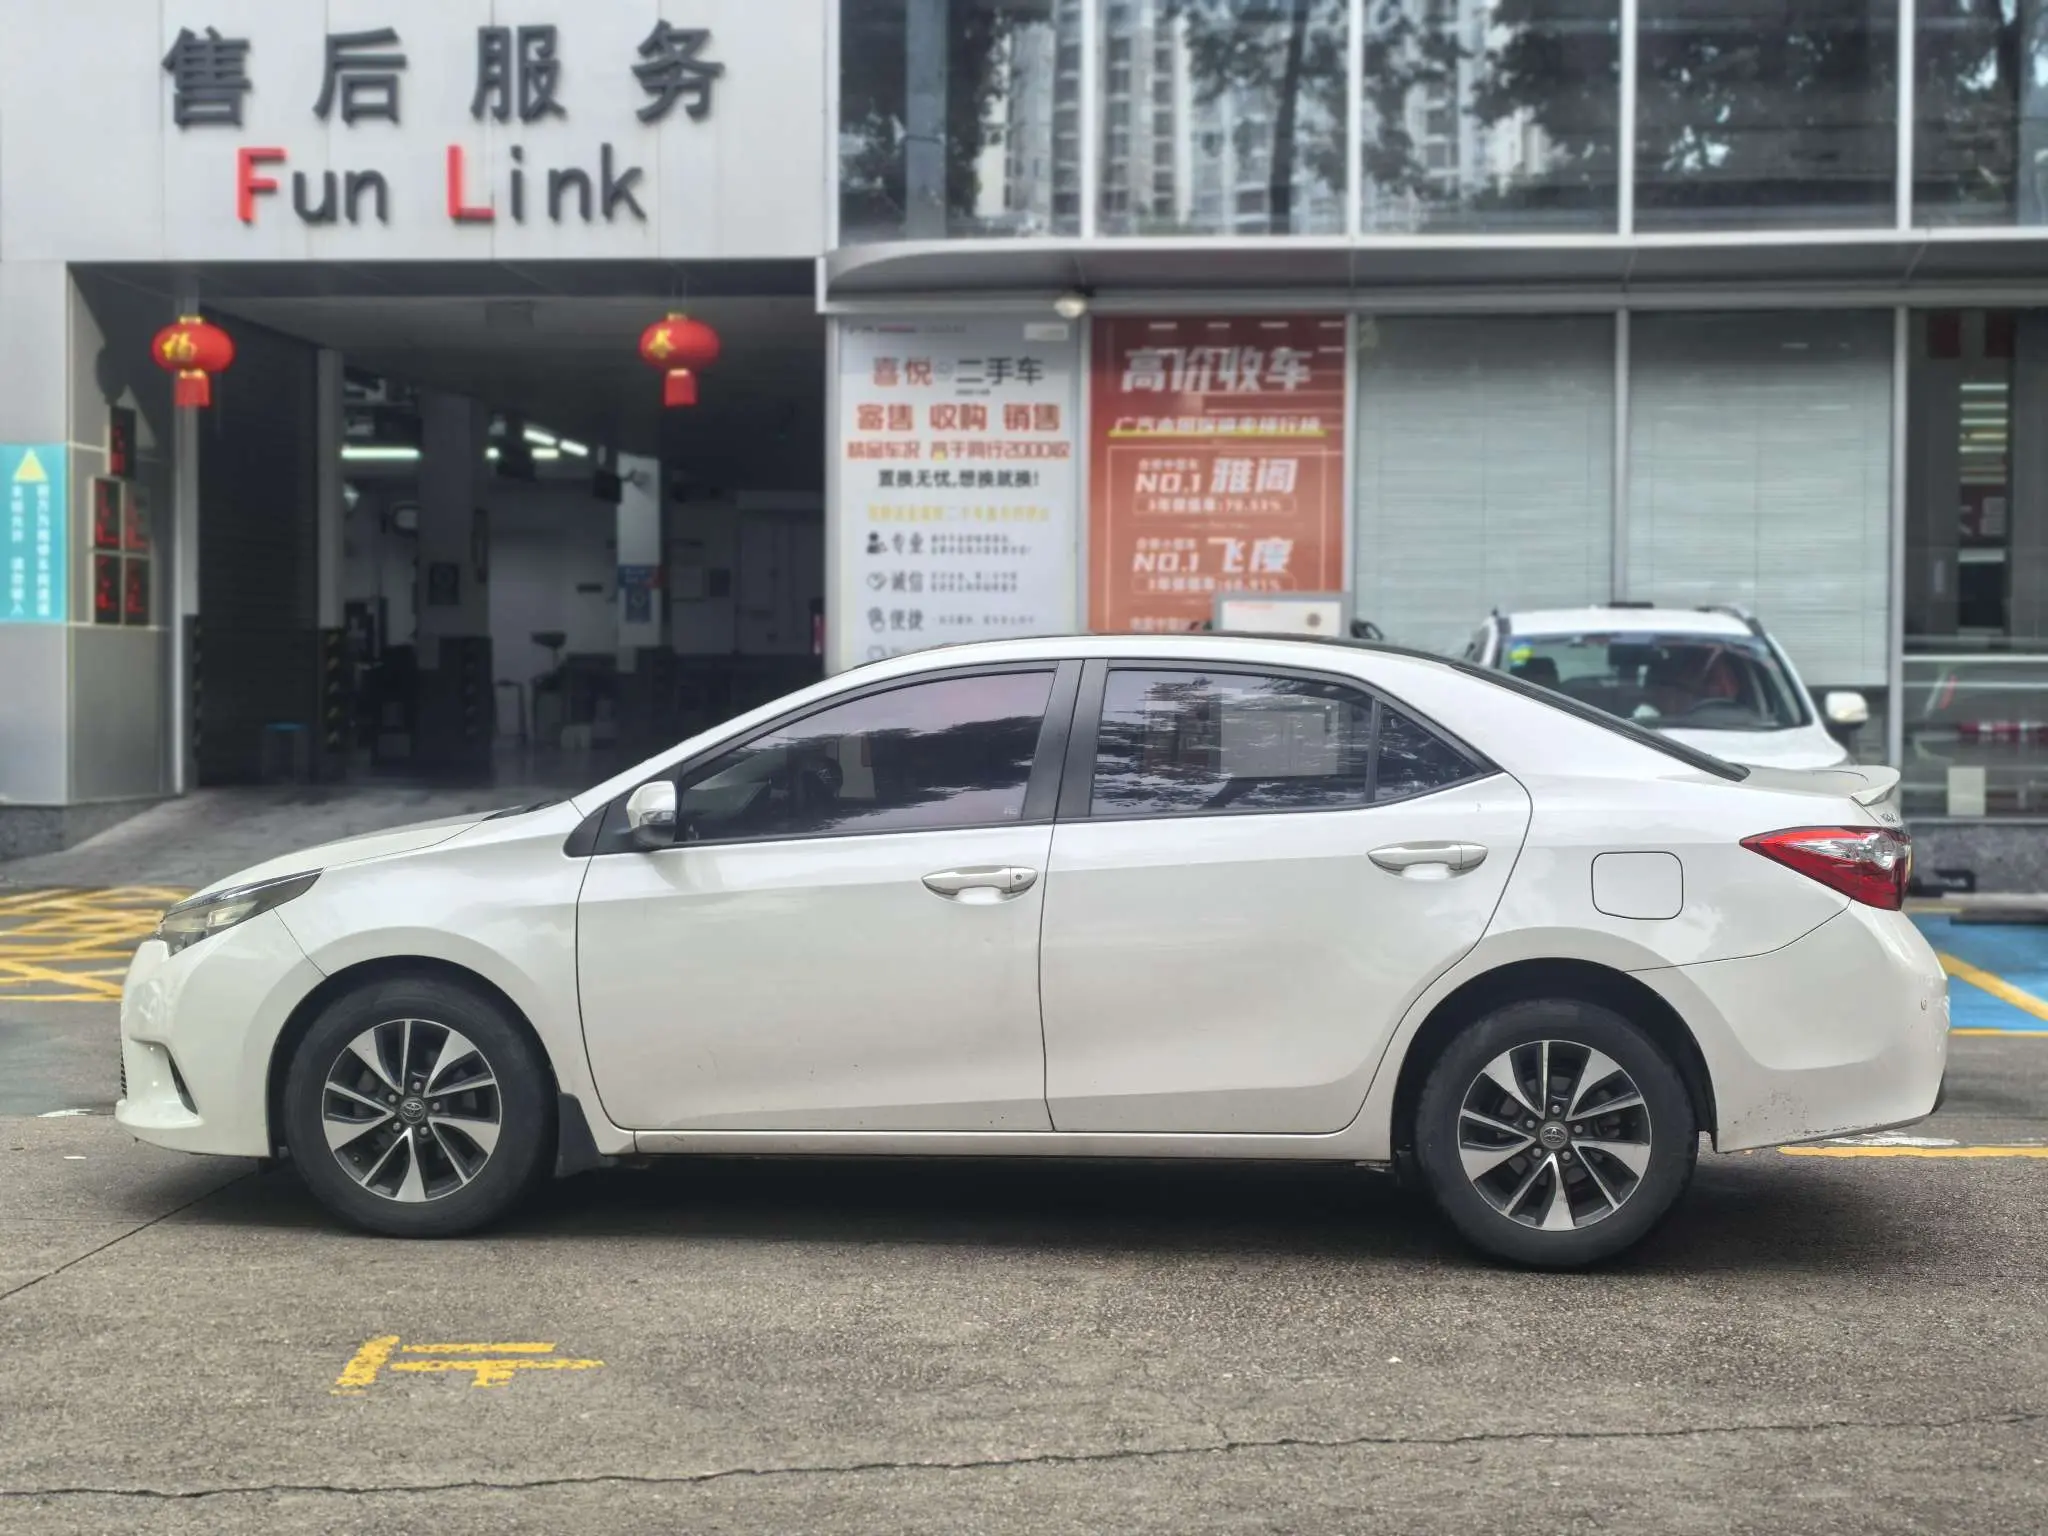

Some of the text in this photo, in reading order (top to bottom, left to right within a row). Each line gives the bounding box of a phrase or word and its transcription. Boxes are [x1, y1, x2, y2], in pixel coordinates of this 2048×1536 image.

[161, 18, 727, 127] 售后服务
[236, 142, 650, 226] Fun Link
[872, 355, 1045, 387] 喜悦 二手车
[1119, 346, 1314, 394] 高价收车
[856, 402, 1061, 432] 寄售 收购 销售
[1135, 472, 1202, 494] NO.1
[1210, 457, 1299, 494] 雅阁
[1132, 552, 1200, 573] NO.1
[1206, 537, 1295, 573] 飞度
